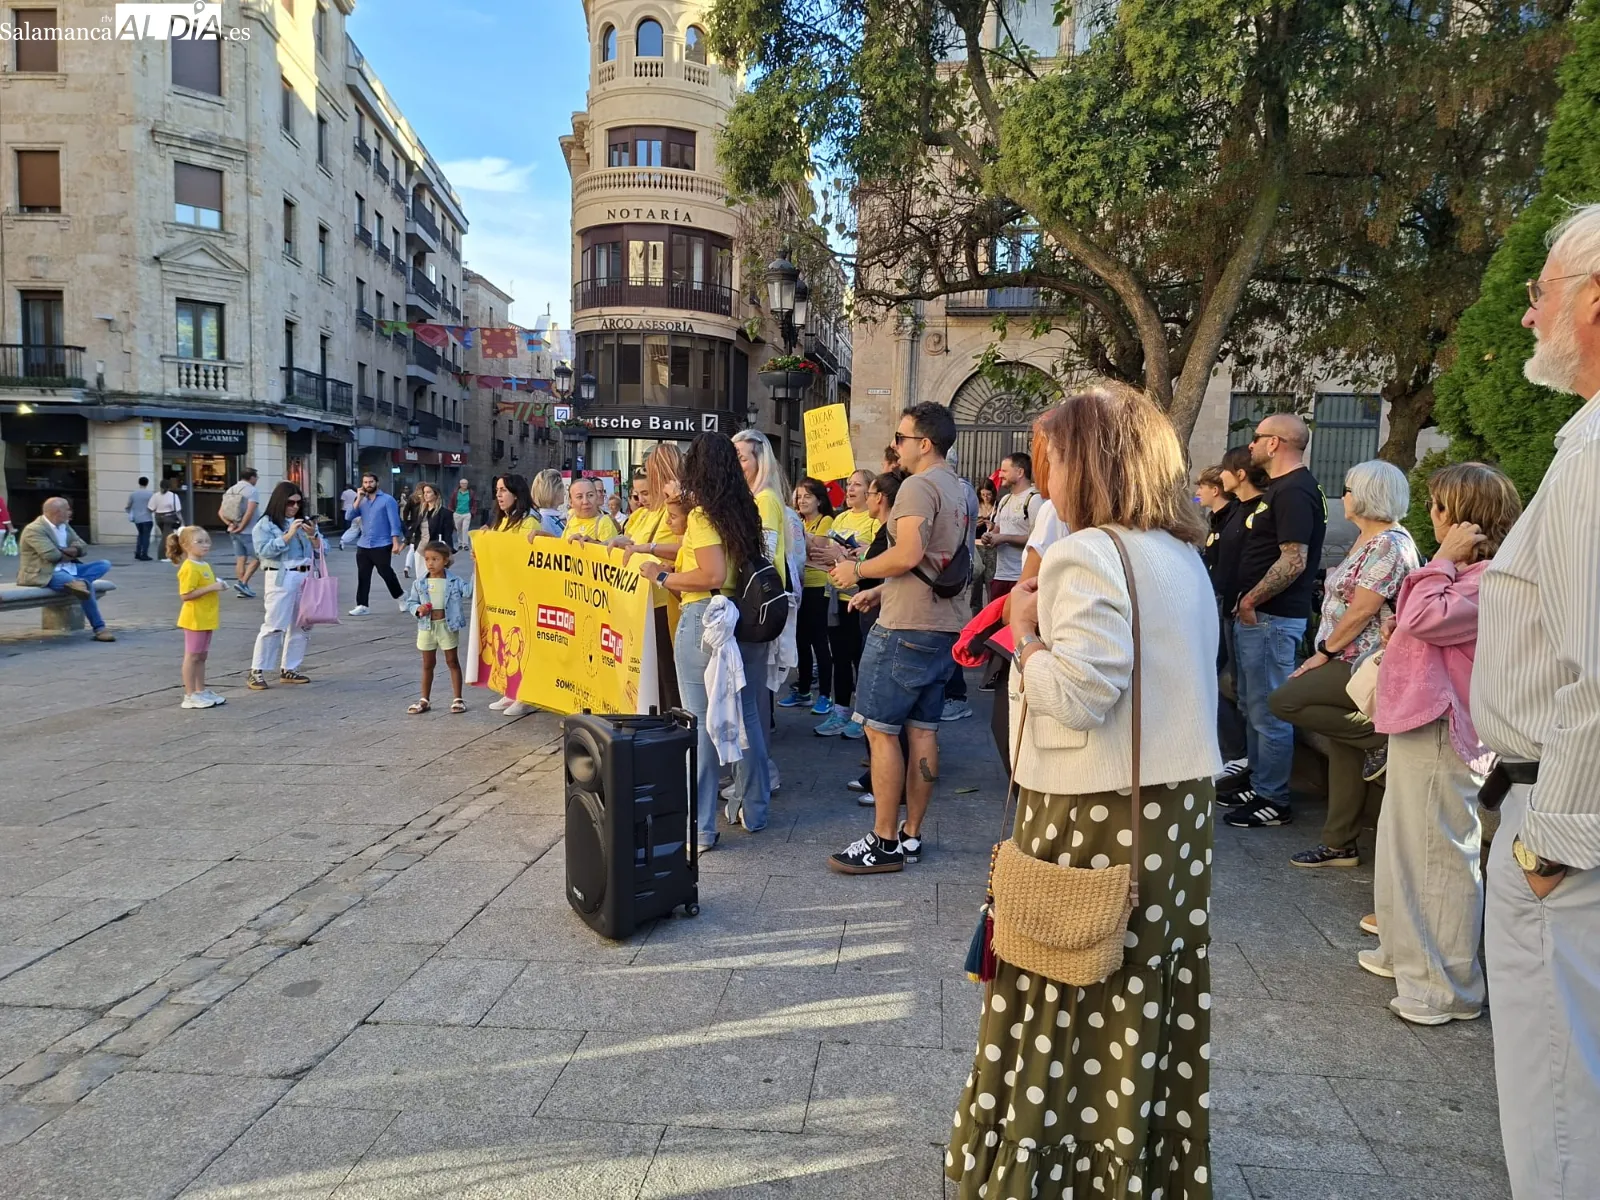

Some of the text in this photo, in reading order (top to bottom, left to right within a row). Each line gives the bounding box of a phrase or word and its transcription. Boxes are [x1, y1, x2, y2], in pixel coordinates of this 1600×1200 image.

[607, 207, 692, 222] NOTARÍA
[601, 318, 633, 330] ARCO
[649, 416, 695, 431] Bank
[527, 551, 584, 577] ABANDNO
